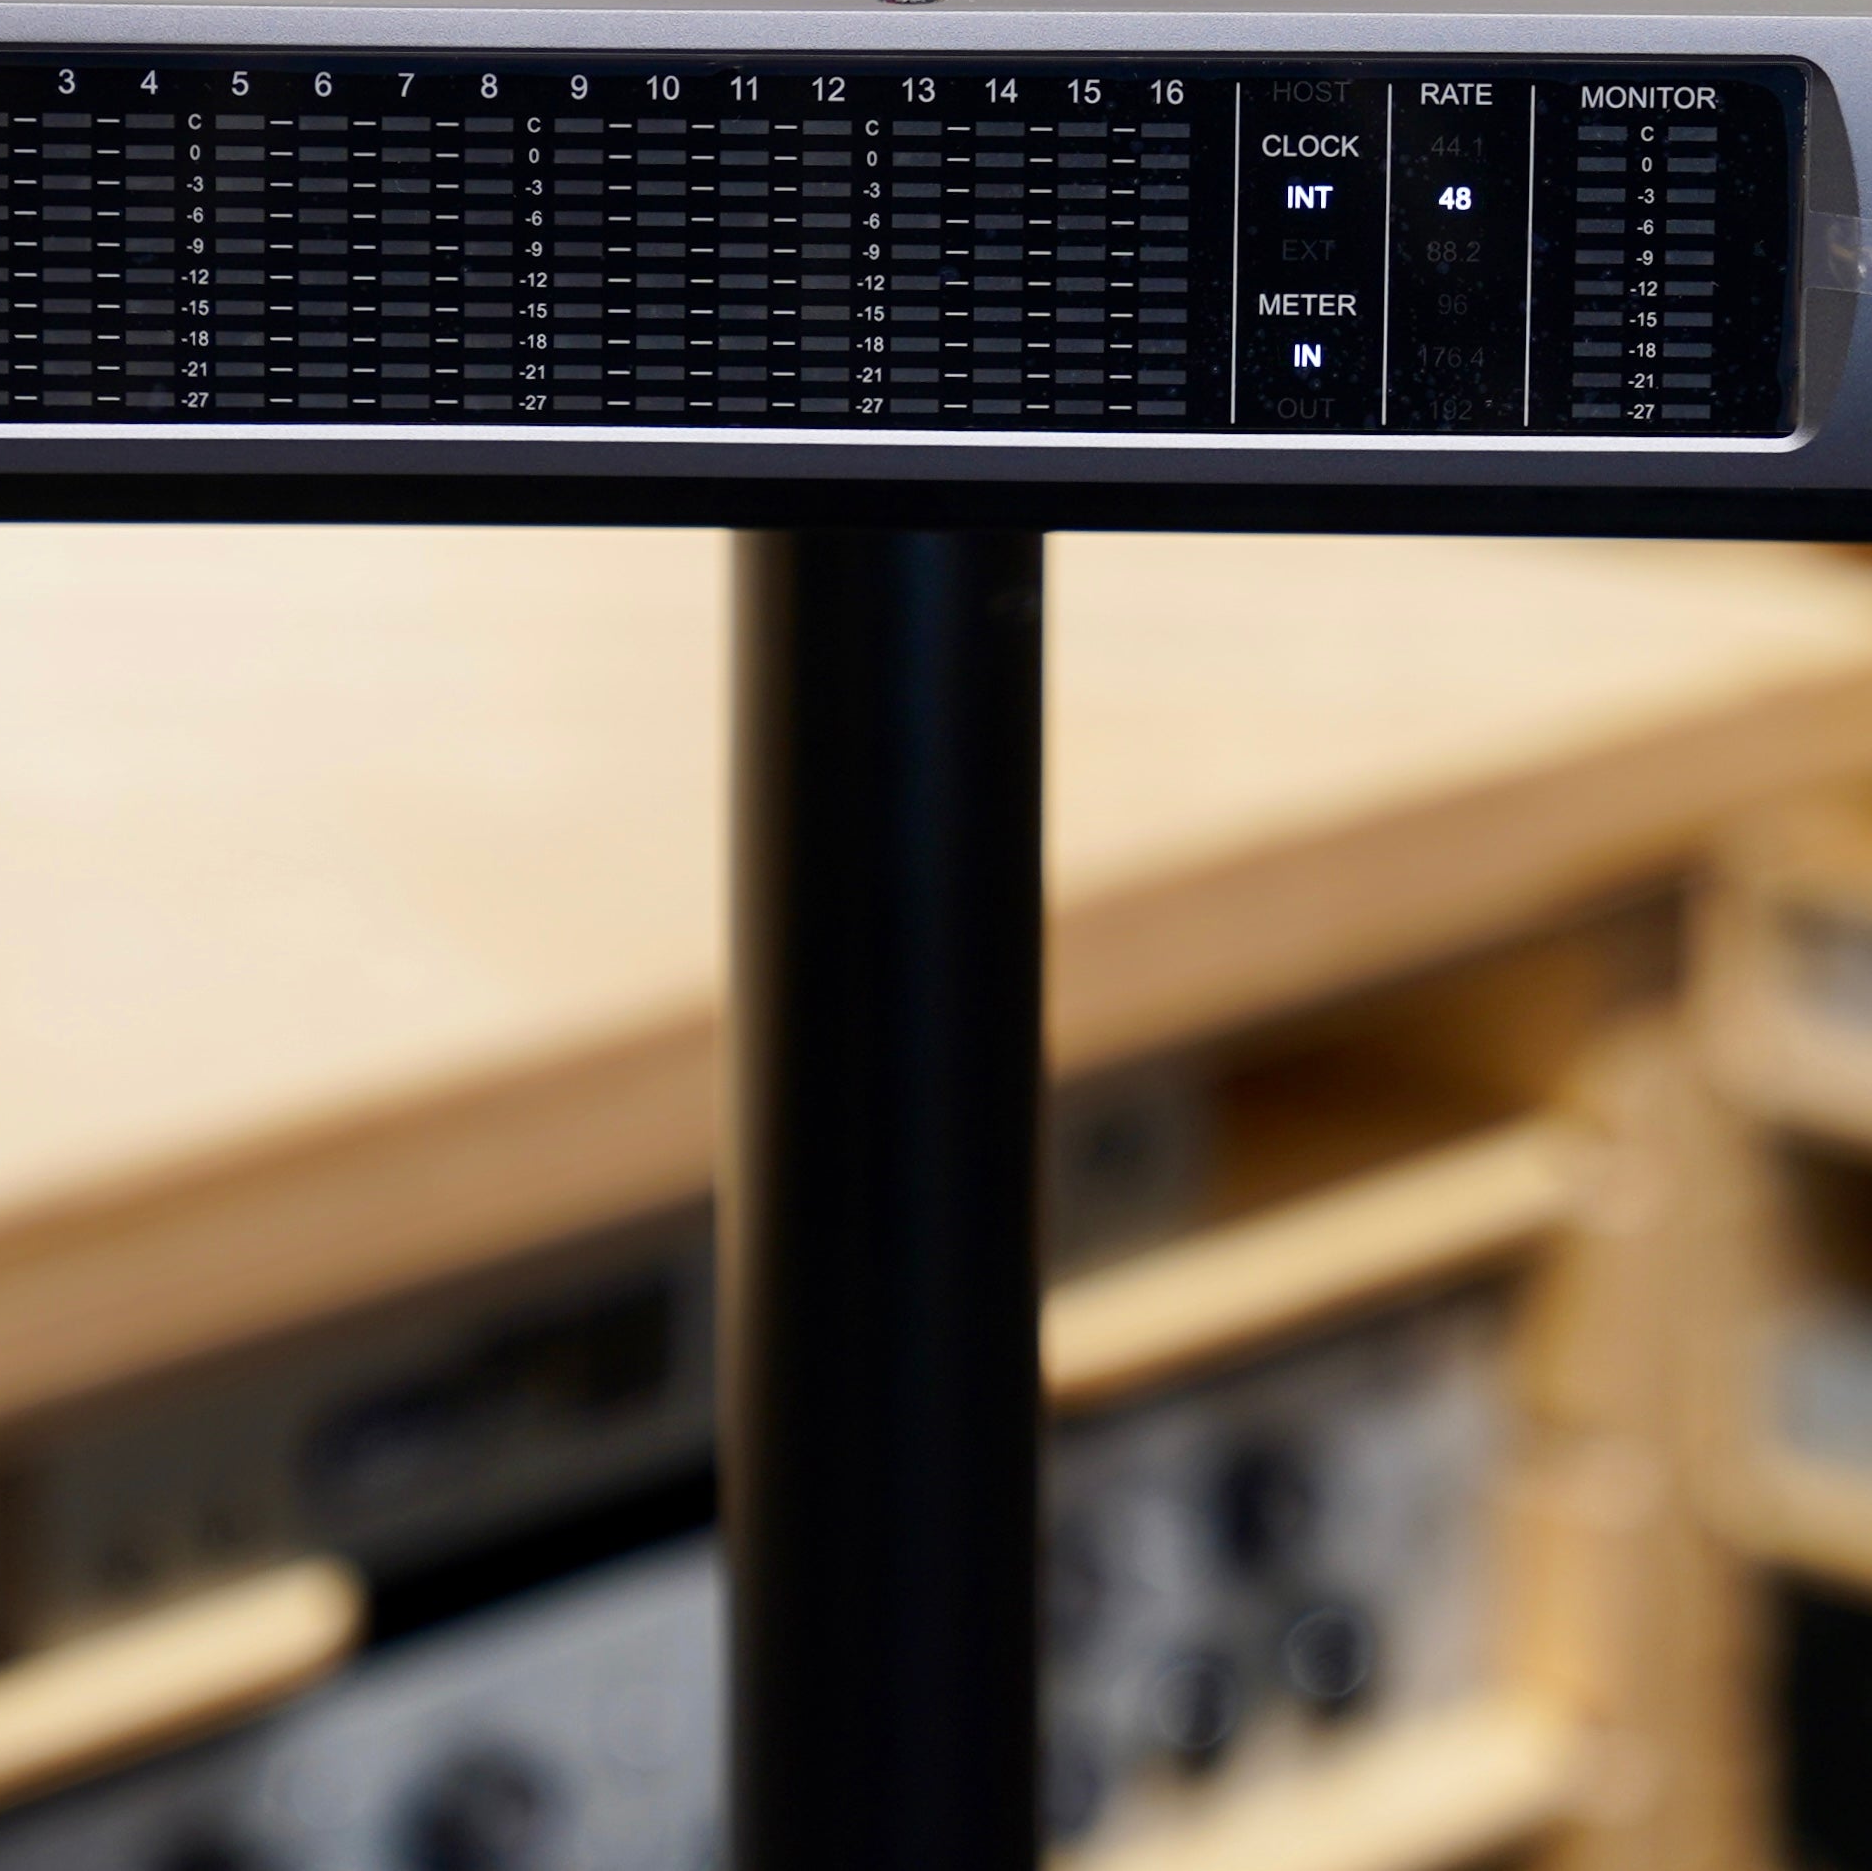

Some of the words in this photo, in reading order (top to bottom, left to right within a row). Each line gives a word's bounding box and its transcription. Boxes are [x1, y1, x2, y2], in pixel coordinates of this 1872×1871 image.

[58, 68, 76, 95] 3
[140, 69, 159, 95] 4
[231, 70, 250, 97] 5
[314, 71, 333, 98] 6
[398, 72, 415, 98] 7
[480, 73, 499, 99] 8
[570, 74, 588, 100] 9
[646, 75, 680, 101] 10
[730, 75, 758, 101] 11
[812, 76, 846, 102] 12
[902, 77, 936, 103] 13
[985, 78, 1019, 104] 14
[1067, 78, 1102, 105] 15
[1150, 79, 1184, 105] 16
[1273, 80, 1353, 103] HOST
[1420, 82, 1493, 106] RATE
[1581, 85, 1716, 110] MONITOR
[187, 113, 202, 131] C
[526, 116, 541, 134] C
[865, 119, 879, 137] C
[1640, 125, 1655, 142] C
[189, 144, 201, 161] 0
[1261, 134, 1360, 158] CLOCK
[1430, 135, 1482, 157] 44.1
[528, 147, 540, 164] 0
[866, 150, 878, 167] 0
[1641, 156, 1653, 173] 0
[186, 175, 205, 193] -3
[525, 179, 543, 196] -3
[863, 181, 881, 199] -3
[1287, 185, 1334, 209] INT
[1438, 186, 1472, 211] 48
[1637, 187, 1655, 205] -3
[186, 206, 204, 224] -6
[525, 209, 543, 227] -6
[862, 212, 881, 230] -6
[1636, 218, 1655, 236] -6
[186, 237, 205, 255] -9
[524, 240, 543, 258] -9
[862, 243, 881, 261] -9
[1282, 239, 1335, 261] EXT
[1426, 240, 1481, 263] 88.2
[1636, 249, 1654, 266] -9
[181, 268, 210, 285] -12
[519, 271, 548, 288] -12
[856, 274, 885, 291] -12
[1629, 280, 1658, 297] -12
[181, 299, 210, 316] -15
[519, 302, 548, 319] -15
[856, 305, 885, 322] -15
[1258, 293, 1357, 316] METER
[1437, 293, 1468, 316] 96
[1629, 311, 1658, 328] -15
[181, 330, 210, 347] -18
[519, 333, 548, 350] -18
[856, 335, 885, 353] -18
[1294, 343, 1322, 368] IN
[1419, 344, 1485, 368] 176.4
[1628, 342, 1657, 359] -18
[181, 360, 207, 378] -21
[519, 363, 545, 380] -21
[856, 366, 882, 384] -21
[1627, 372, 1654, 389] -21
[181, 391, 210, 408] -27
[518, 394, 547, 411] -27
[855, 397, 884, 414] -27
[1276, 397, 1335, 420] OUT
[1432, 399, 1473, 422] 192
[1626, 403, 1655, 420] -27
